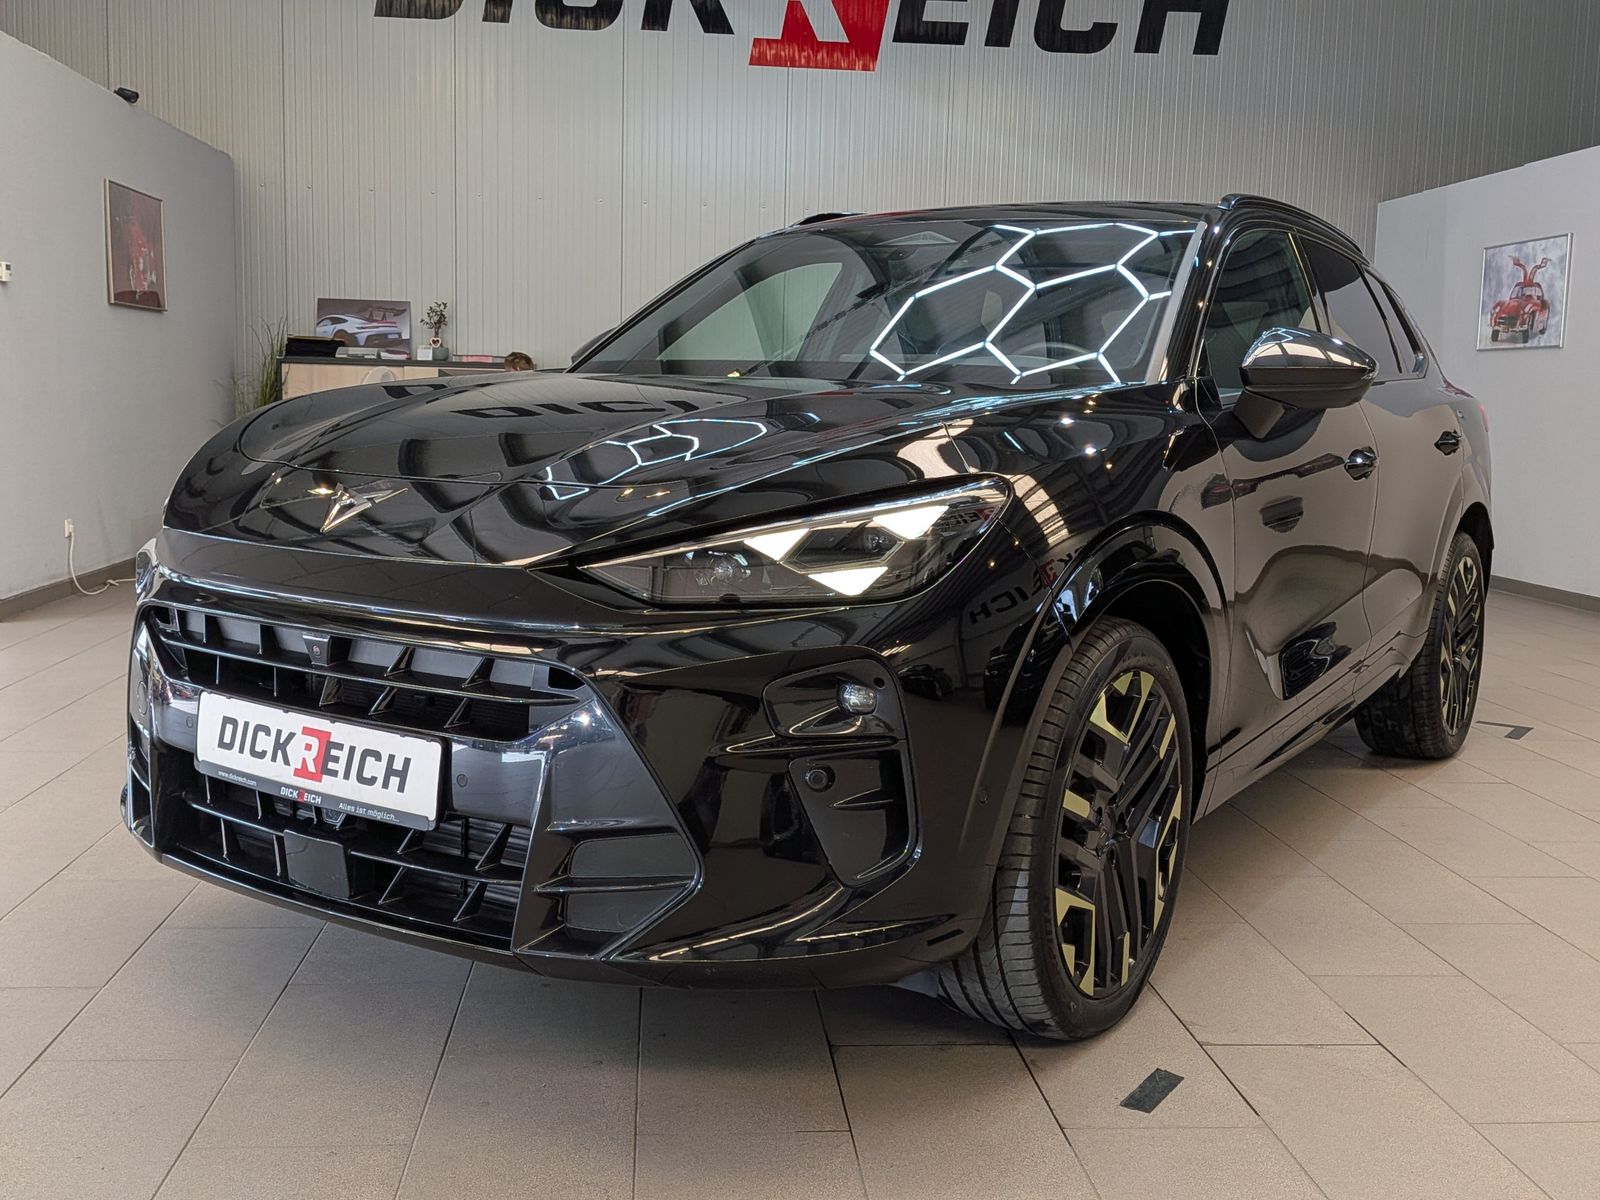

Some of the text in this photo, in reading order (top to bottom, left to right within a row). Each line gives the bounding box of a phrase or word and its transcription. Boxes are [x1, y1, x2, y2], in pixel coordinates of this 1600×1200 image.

[217, 715, 412, 793] DICKREICH
[338, 802, 356, 813] Alles
[356, 806, 367, 815] ist
